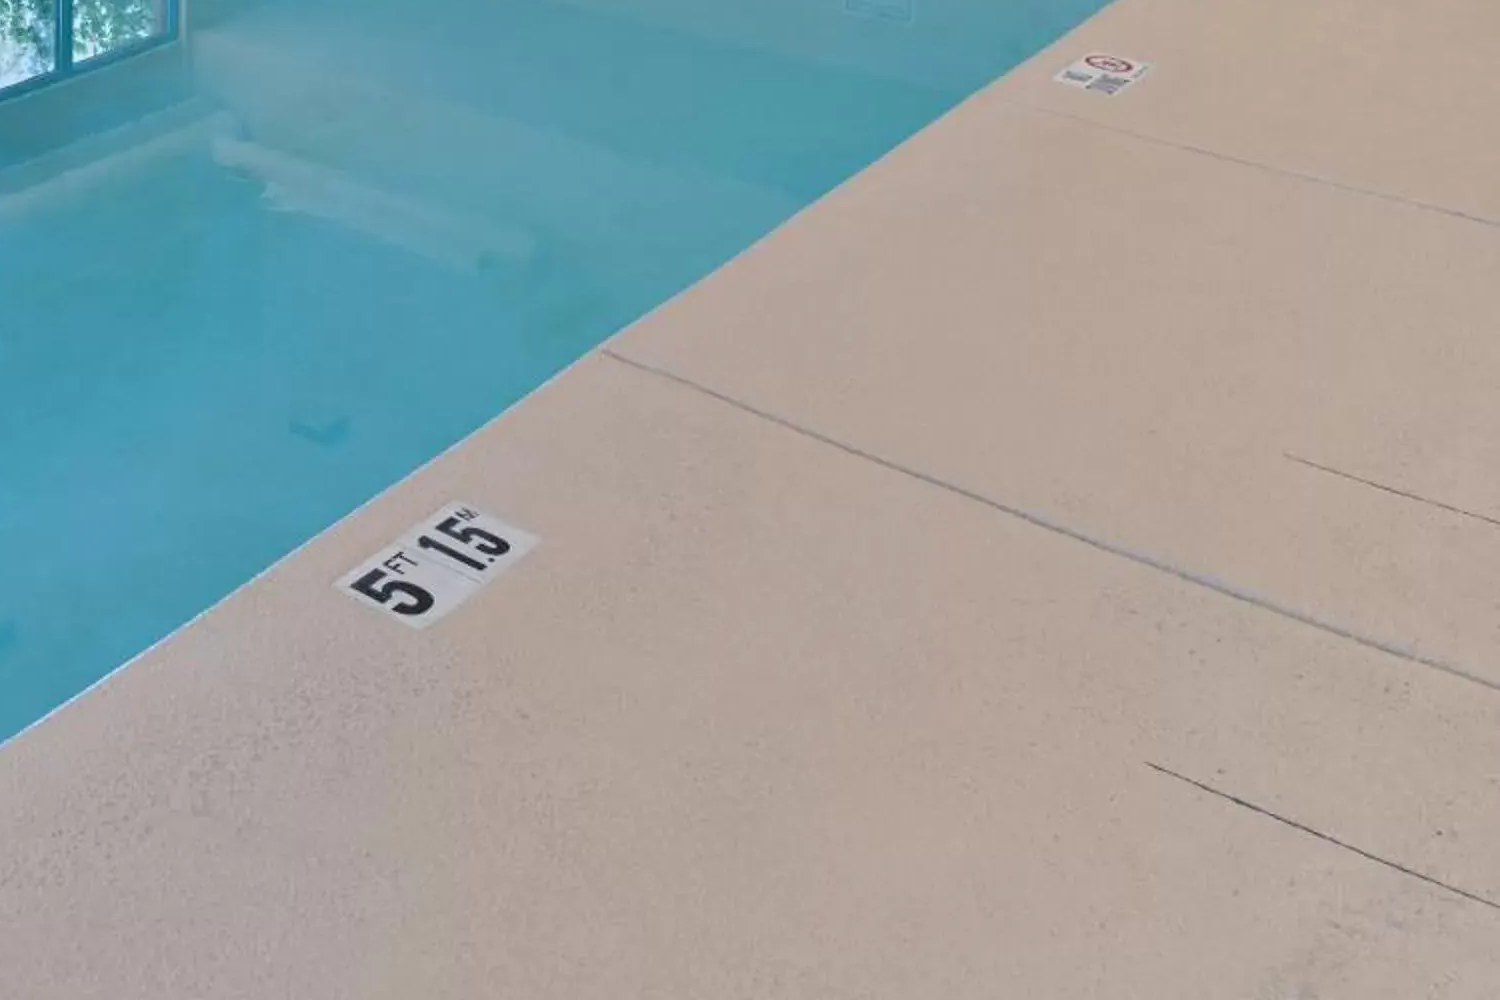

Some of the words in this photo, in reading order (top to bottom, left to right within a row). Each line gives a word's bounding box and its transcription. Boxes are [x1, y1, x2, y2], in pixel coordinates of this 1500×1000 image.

[382, 551, 419, 576] FT
[417, 515, 512, 572] 1.5
[350, 568, 435, 616] 5
